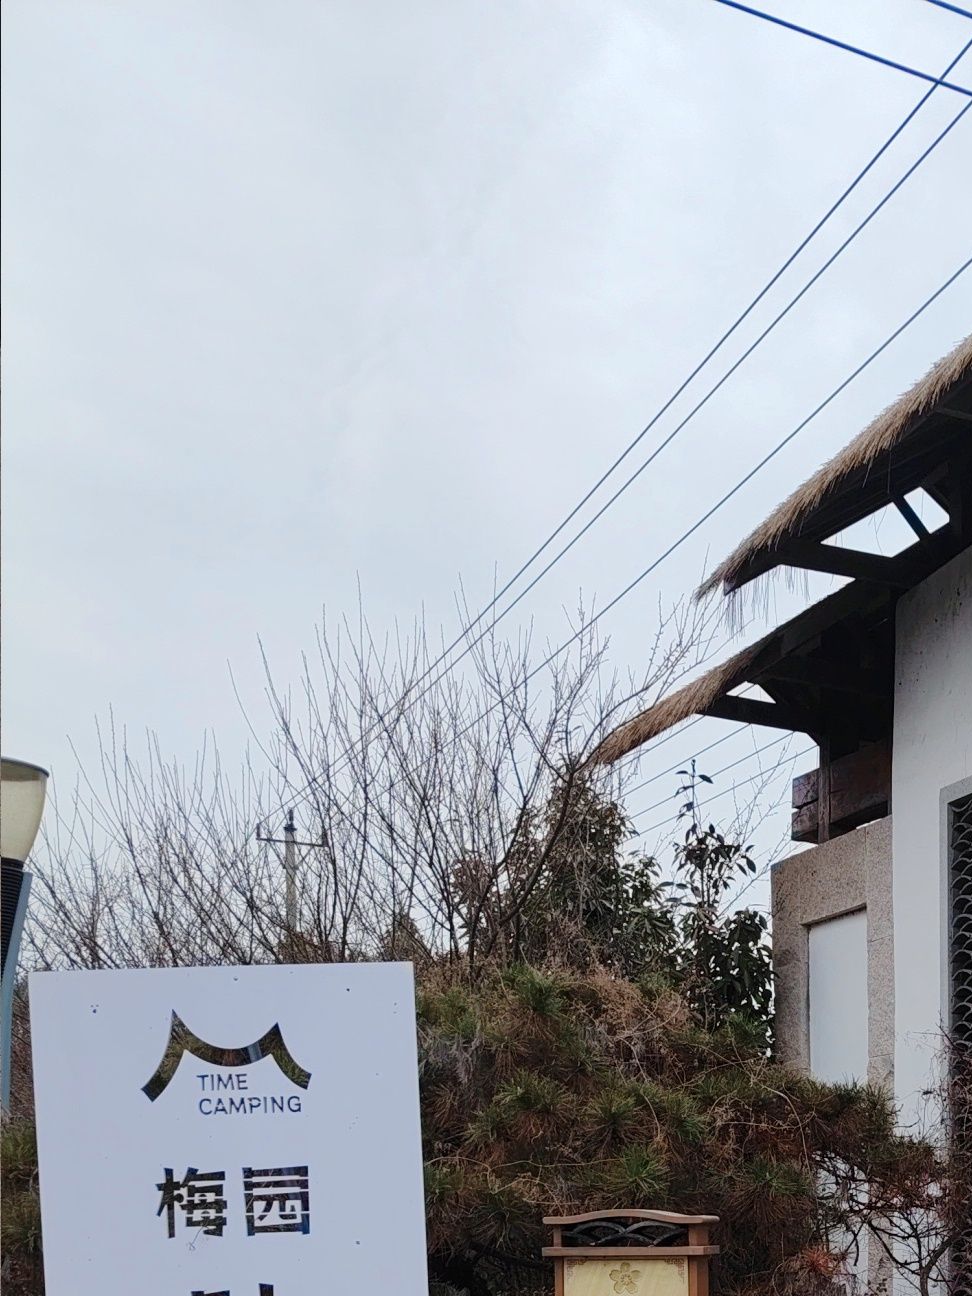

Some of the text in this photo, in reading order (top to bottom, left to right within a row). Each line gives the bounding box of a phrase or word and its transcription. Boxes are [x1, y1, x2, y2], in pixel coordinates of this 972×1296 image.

[197, 1072, 249, 1092] TIME
[199, 1095, 302, 1115] CAMPING
[155, 1165, 310, 1239] 梅园
